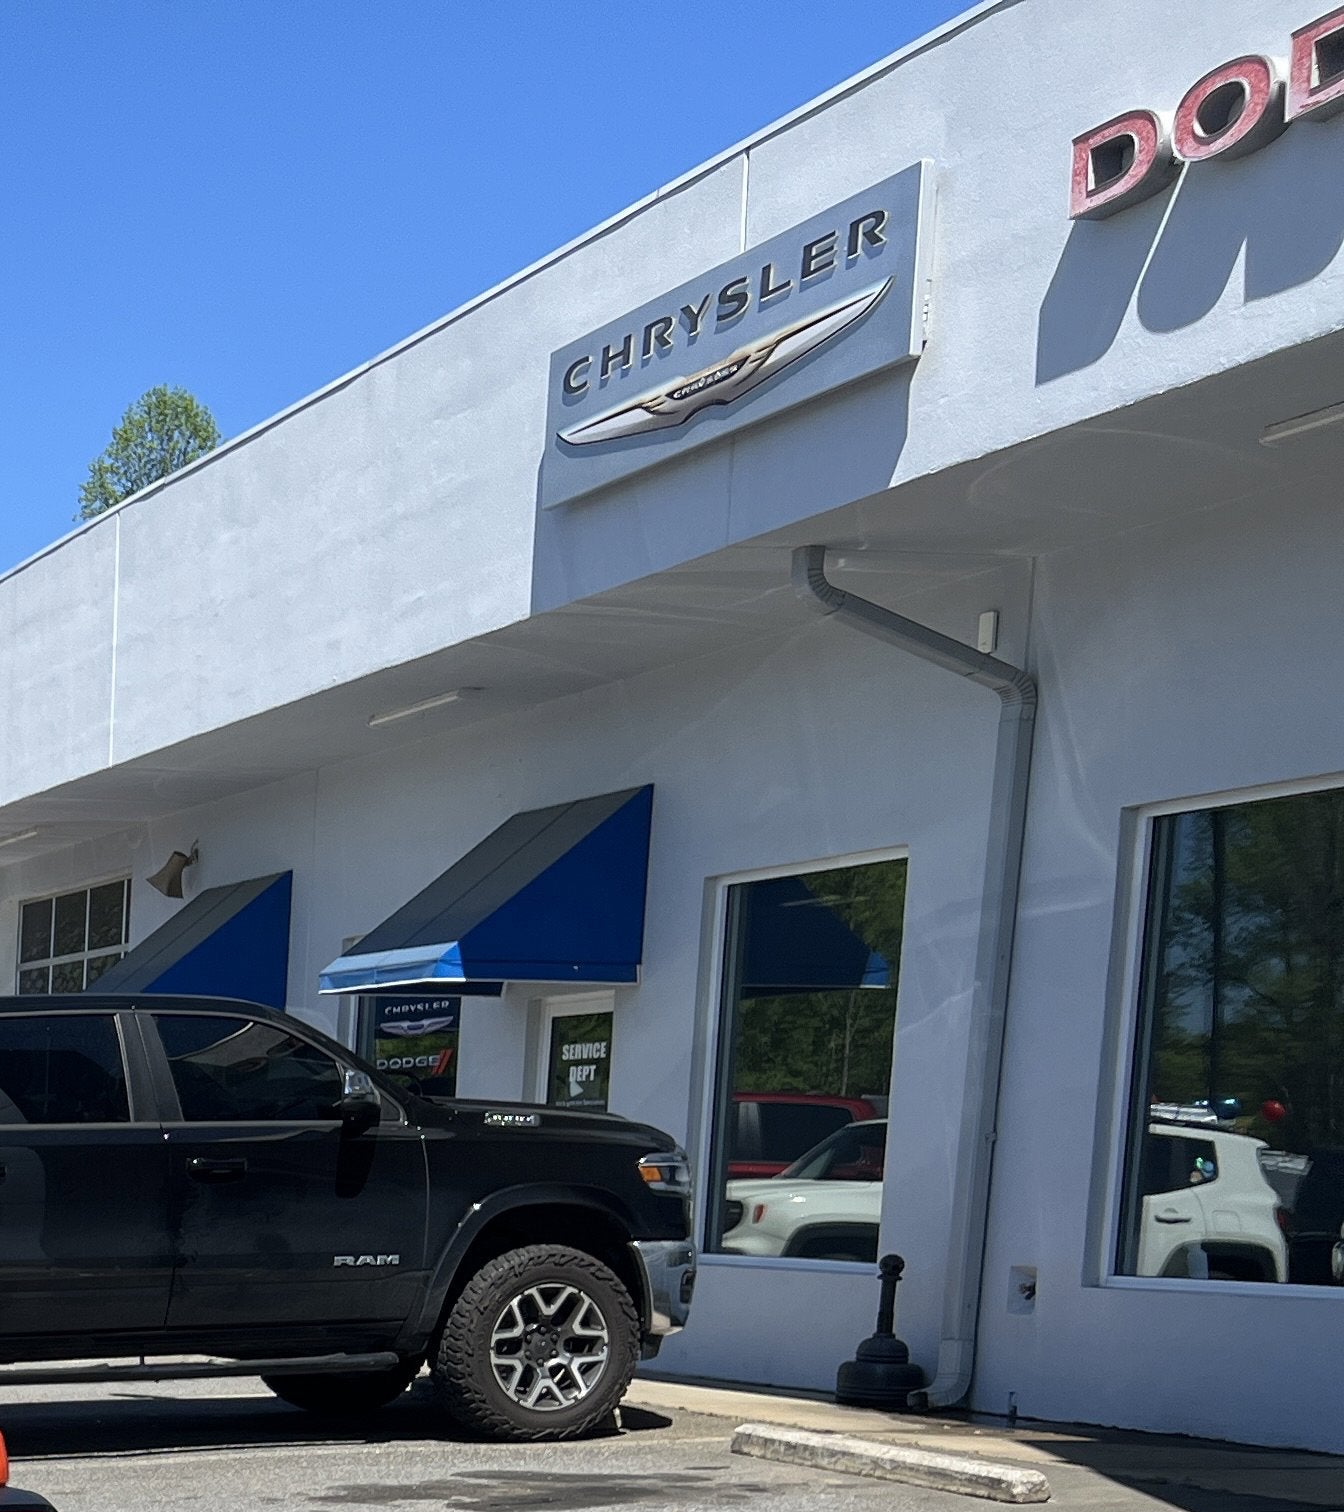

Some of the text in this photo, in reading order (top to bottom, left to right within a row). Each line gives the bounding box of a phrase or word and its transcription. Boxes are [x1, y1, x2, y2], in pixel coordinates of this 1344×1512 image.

[563, 209, 889, 396] CHRYSLER
[384, 1000, 450, 1016] CHRYSLER
[562, 1041, 608, 1061] SERVICE
[376, 1054, 441, 1070] DODGE
[569, 1064, 597, 1082] DEPT
[333, 1254, 400, 1267] RAM
